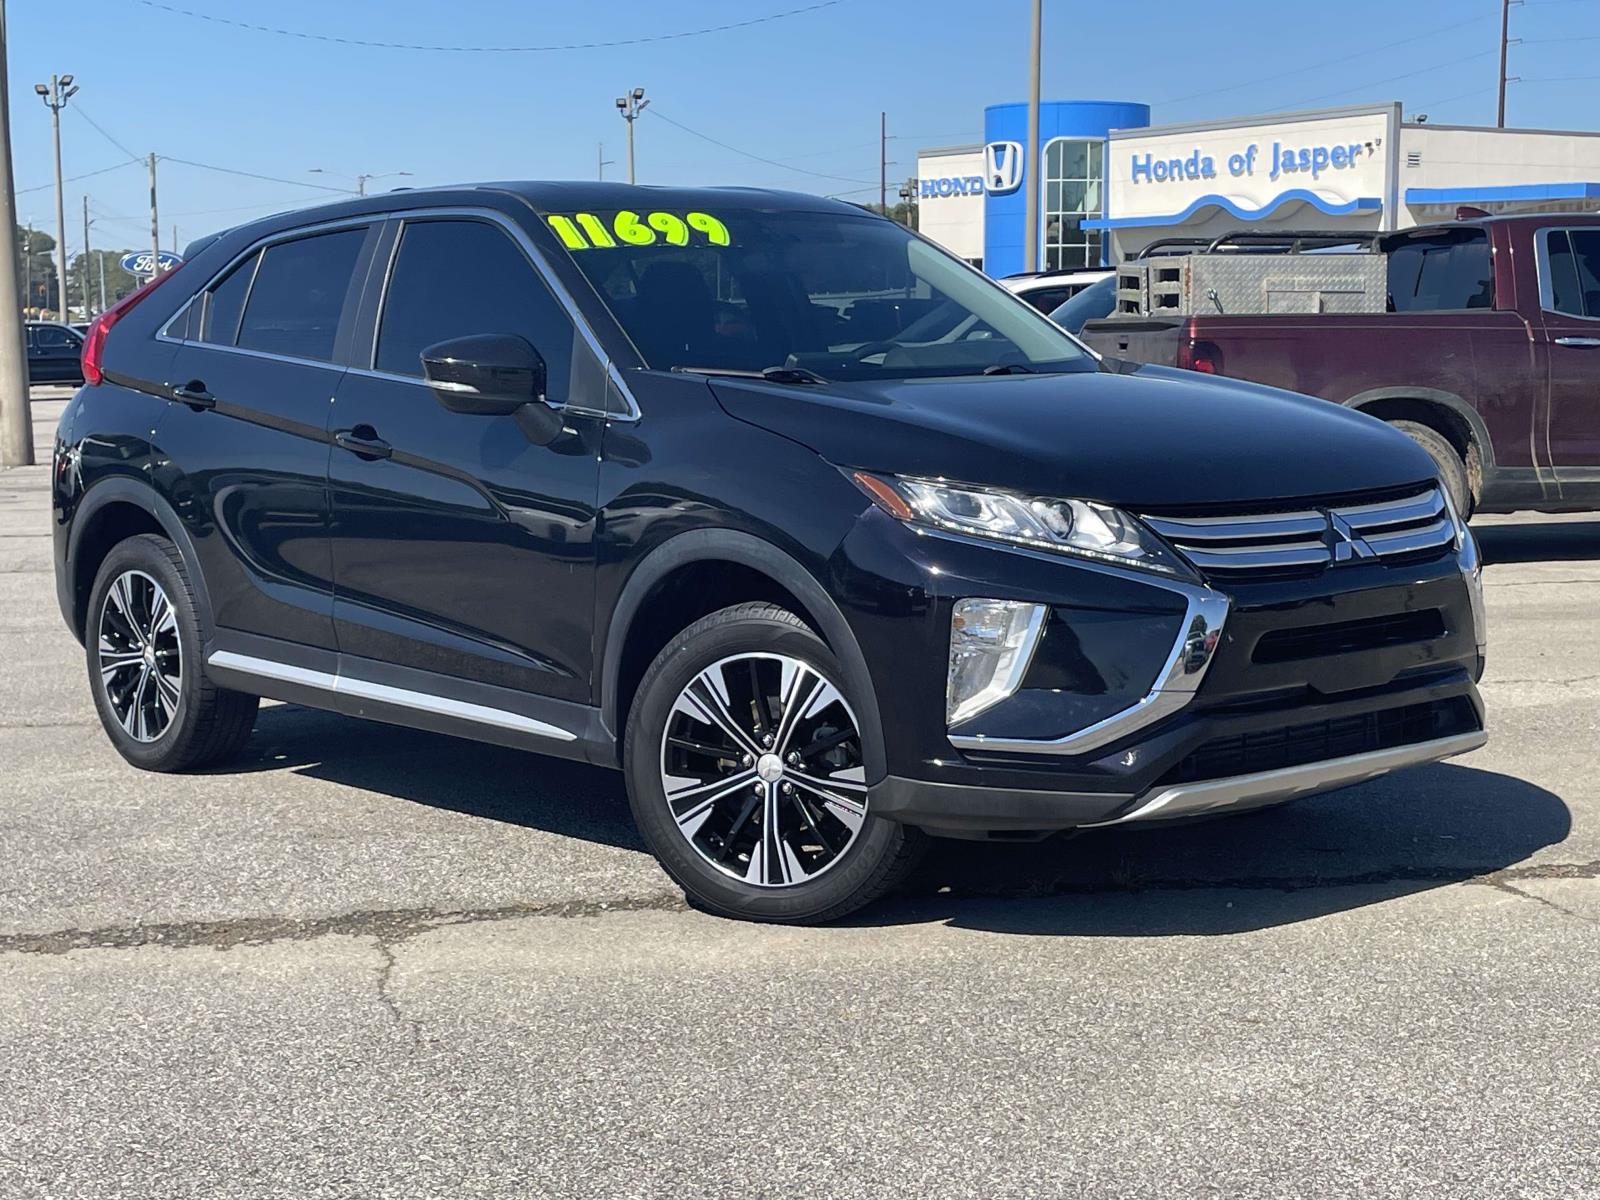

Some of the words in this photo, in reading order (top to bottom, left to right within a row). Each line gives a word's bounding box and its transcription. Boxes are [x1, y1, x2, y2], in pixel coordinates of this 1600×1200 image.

[1131, 149, 1215, 182] Honda
[1228, 144, 1257, 176] of
[1269, 142, 1362, 180] Jasper
[920, 176, 983, 197] HOND
[547, 210, 730, 249] 11699
